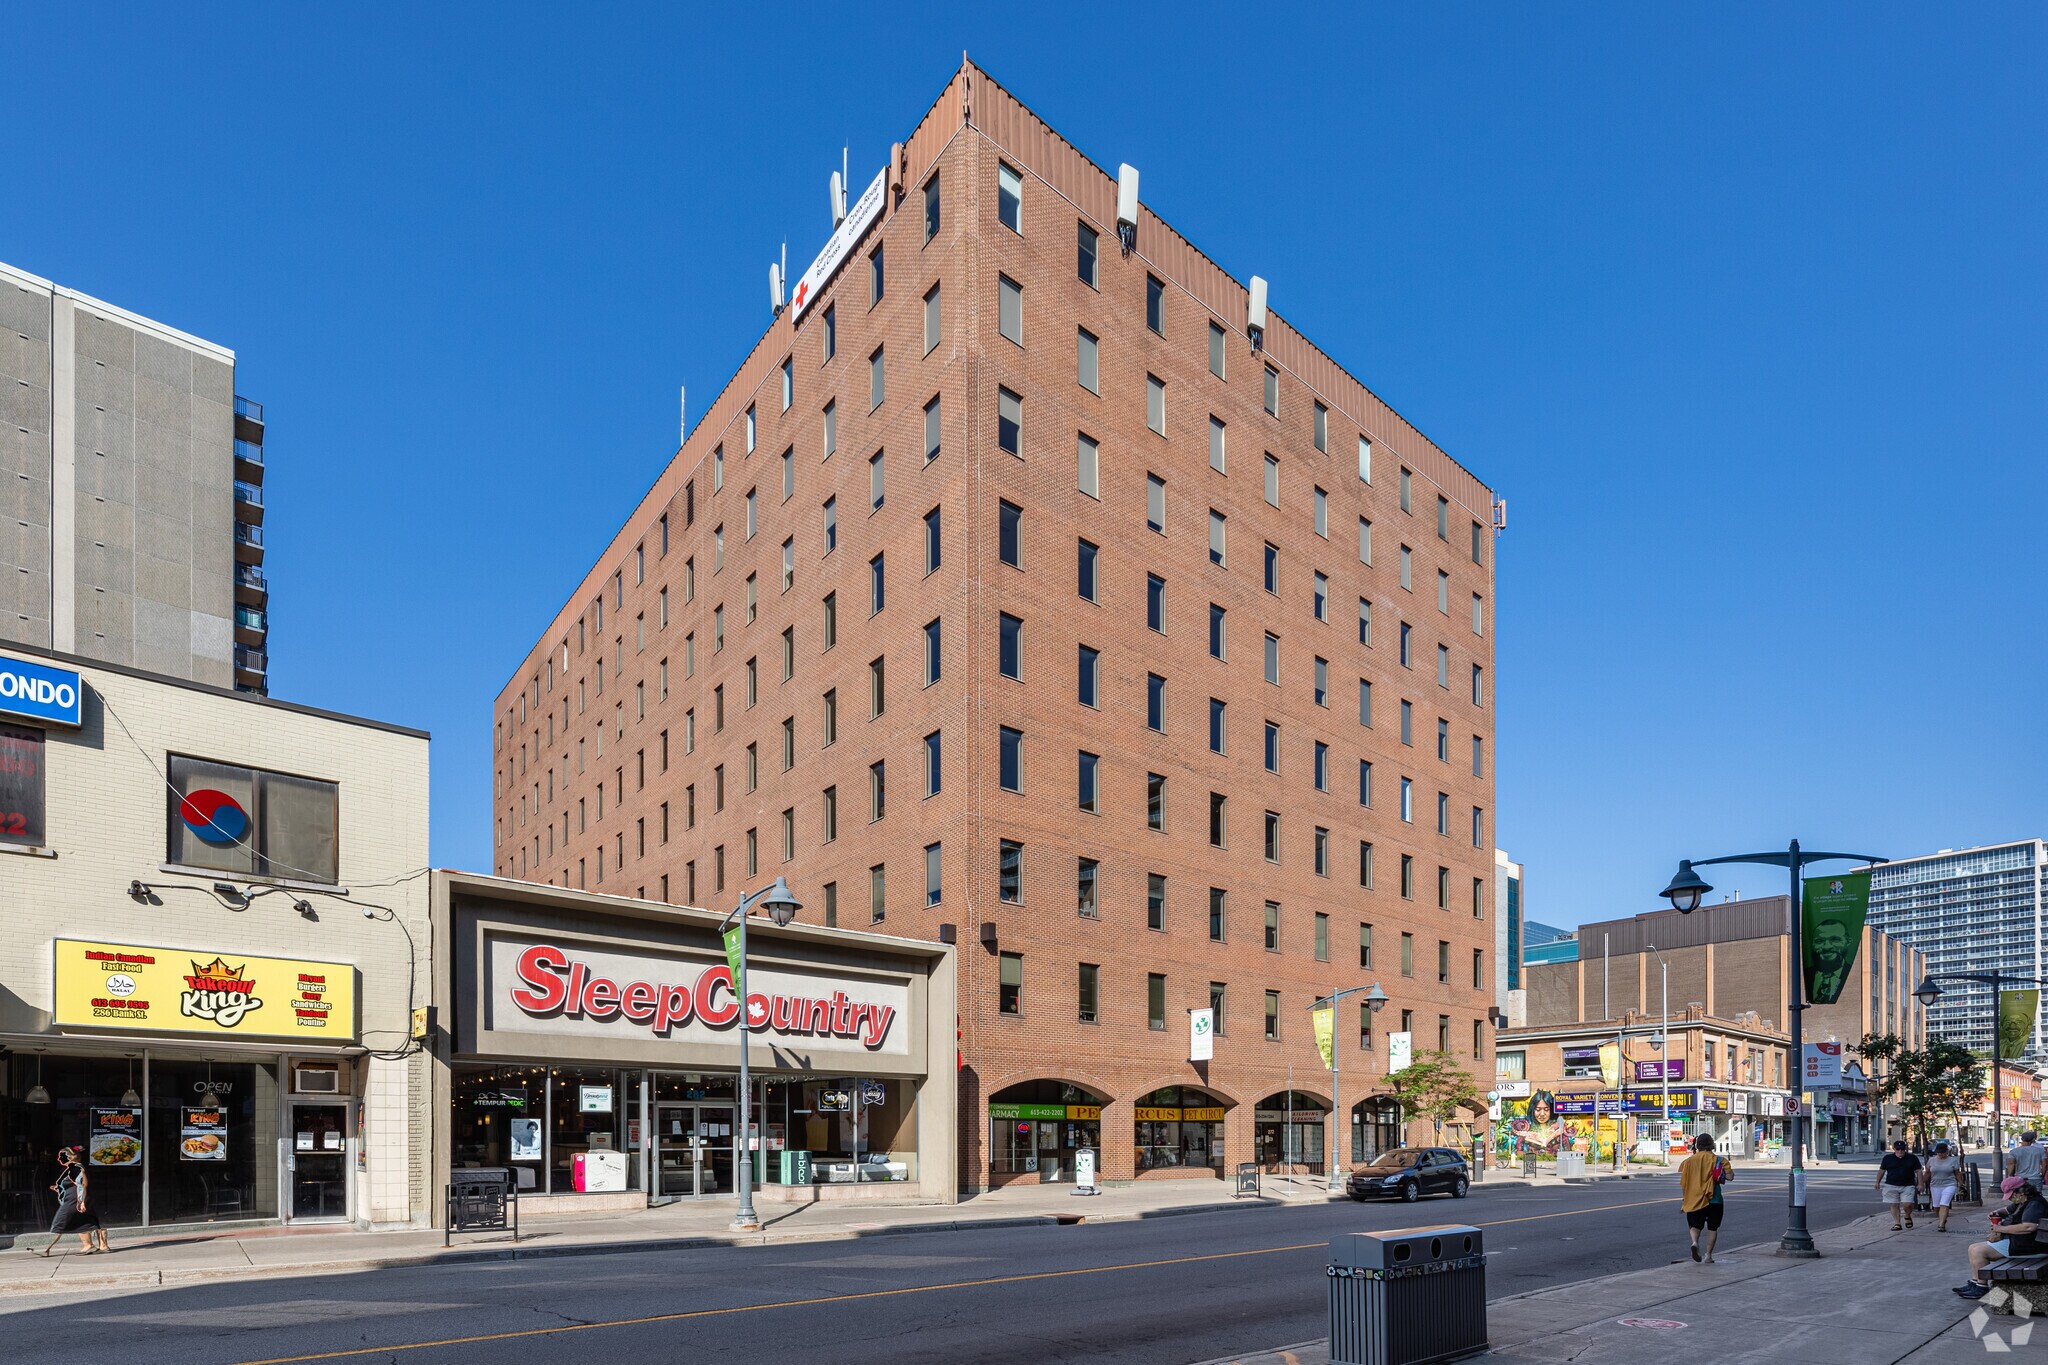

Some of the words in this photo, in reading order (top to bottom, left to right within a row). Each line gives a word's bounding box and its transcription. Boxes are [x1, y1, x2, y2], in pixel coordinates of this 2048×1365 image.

[85, 951, 115, 961] Indian
[116, 953, 155, 964] Canadian
[102, 962, 120, 971] Fast
[121, 963, 142, 973] Food
[107, 977, 134, 988] حلال
[298, 974, 325, 983] Biryani
[183, 976, 256, 994] Takeout
[297, 982, 326, 992] Burgers
[302, 992, 322, 1001] Curry
[91, 998, 108, 1007] 613
[109, 999, 126, 1008] 695
[127, 1000, 149, 1009] 9595
[181, 989, 263, 1027] King
[291, 1000, 332, 1010] Sandwiches
[93, 1008, 111, 1017] 286
[112, 1009, 135, 1018] Bank
[136, 1010, 147, 1019] St.
[295, 1009, 328, 1018] Tandoori
[297, 1018, 326, 1027] Poutine
[193, 1081, 233, 1092] OPEN
[686, 1089, 706, 1100] 282
[190, 1112, 220, 1123] KING
[1076, 1107, 1100, 1119] PE
[1184, 1109, 1198, 1119] PET
[100, 1114, 134, 1125] KING
